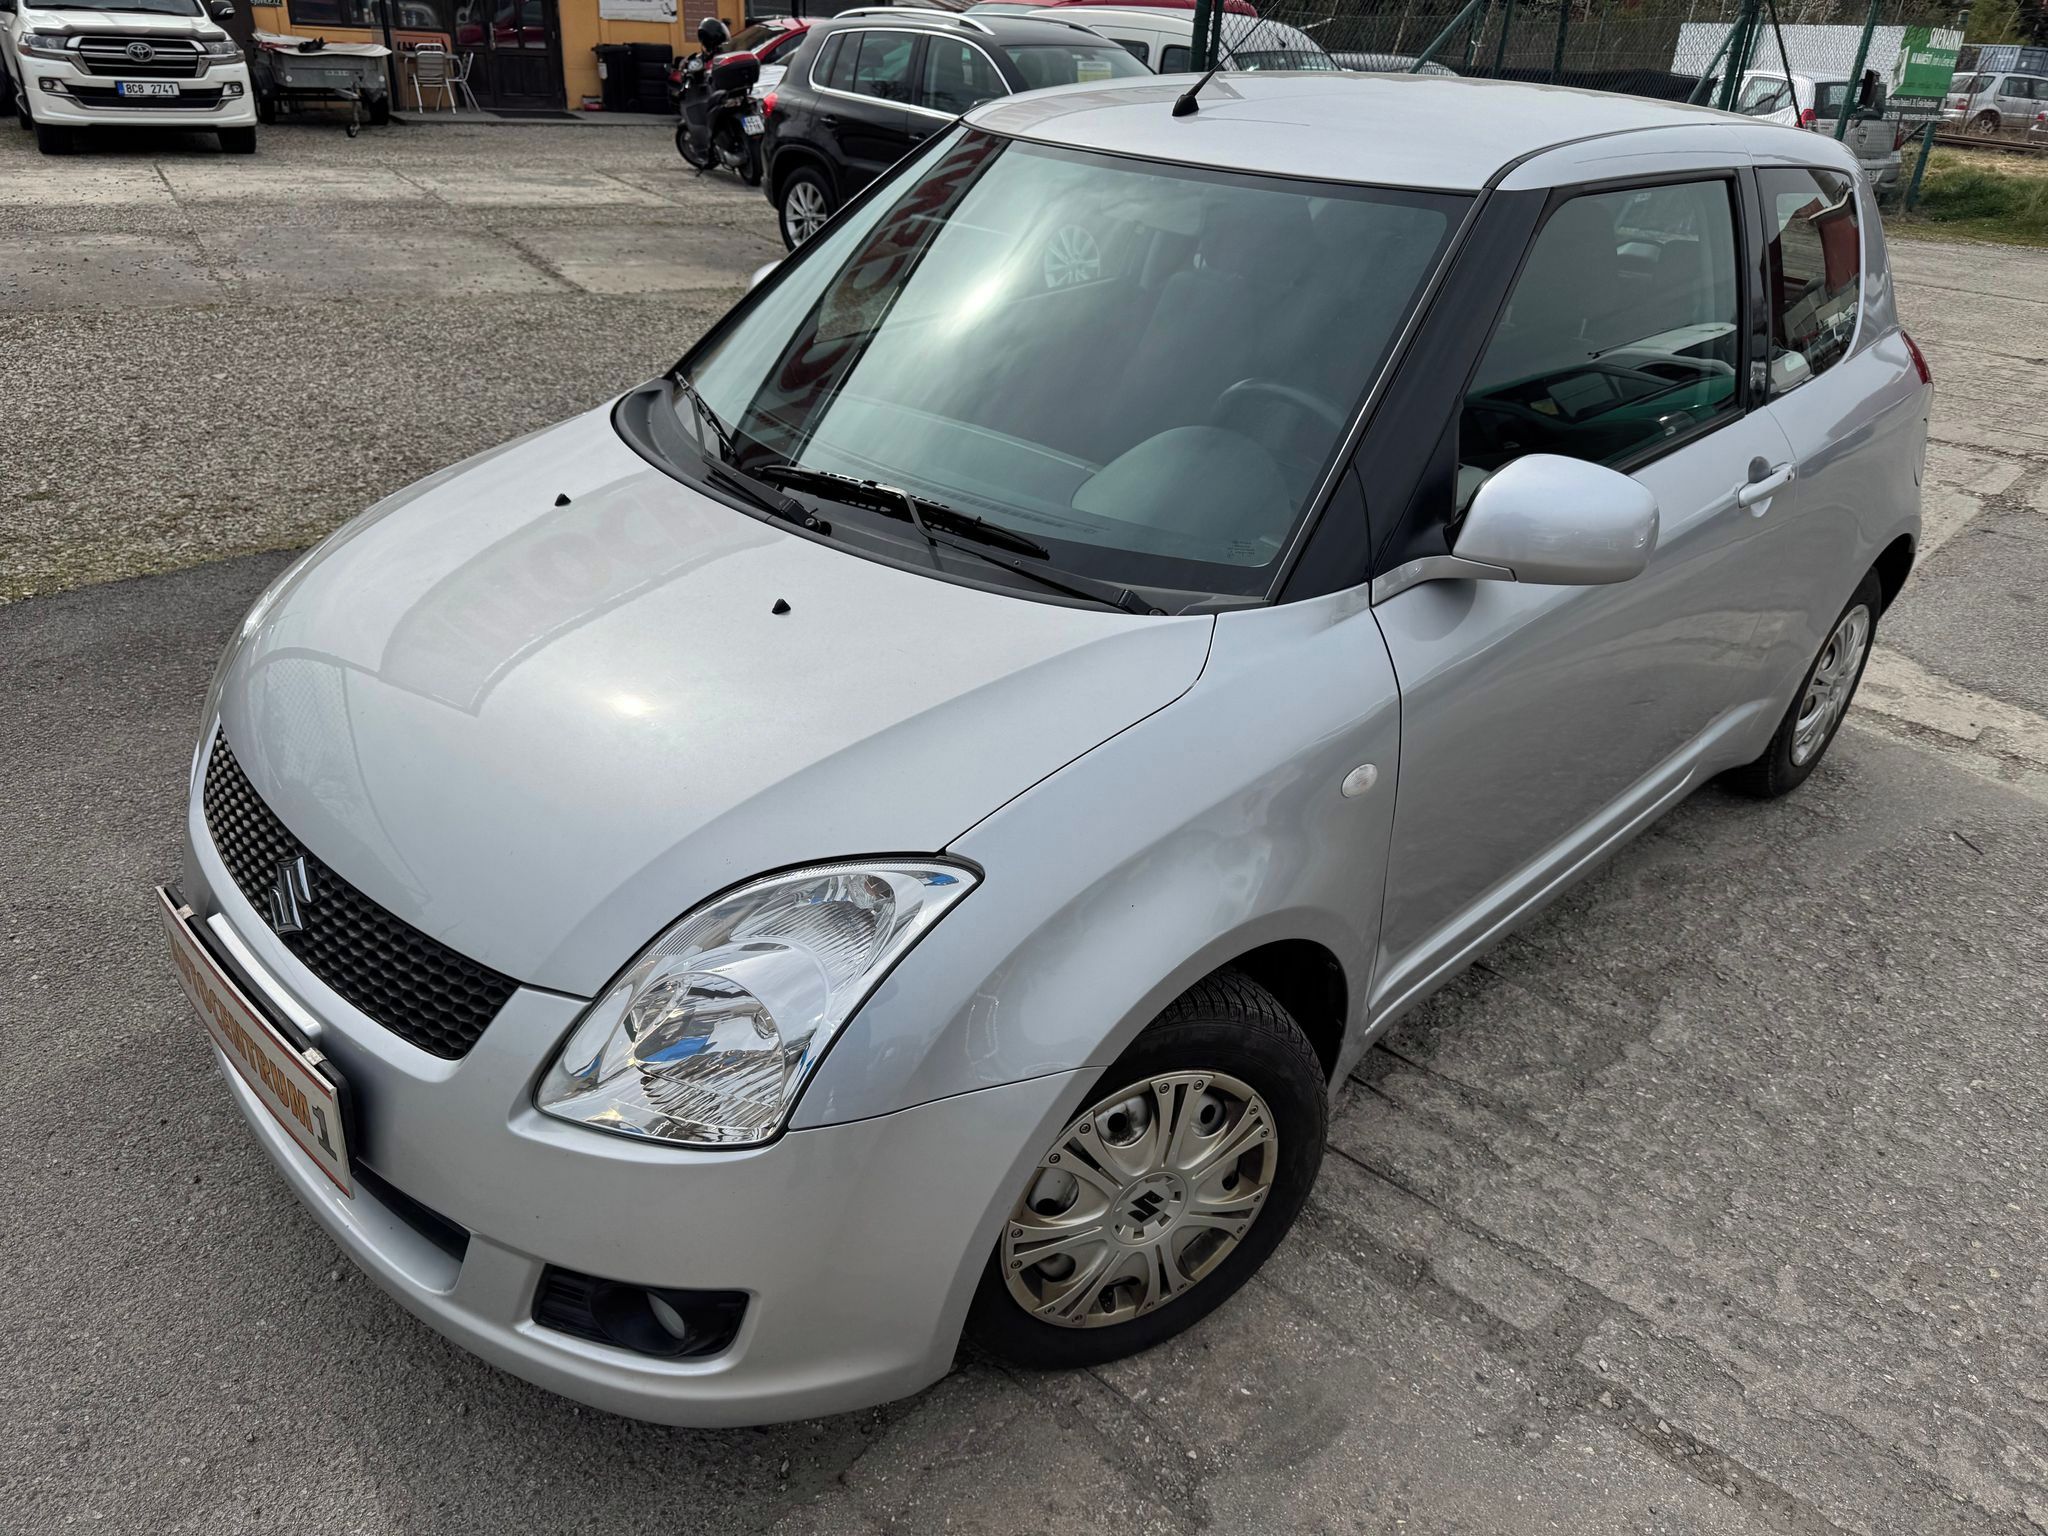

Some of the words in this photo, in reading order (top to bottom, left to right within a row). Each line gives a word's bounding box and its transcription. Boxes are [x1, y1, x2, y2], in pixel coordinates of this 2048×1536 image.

[150, 84, 174, 94] 2741
[168, 928, 315, 1136] AUTOCENTRUM
[312, 1104, 338, 1162] 1
